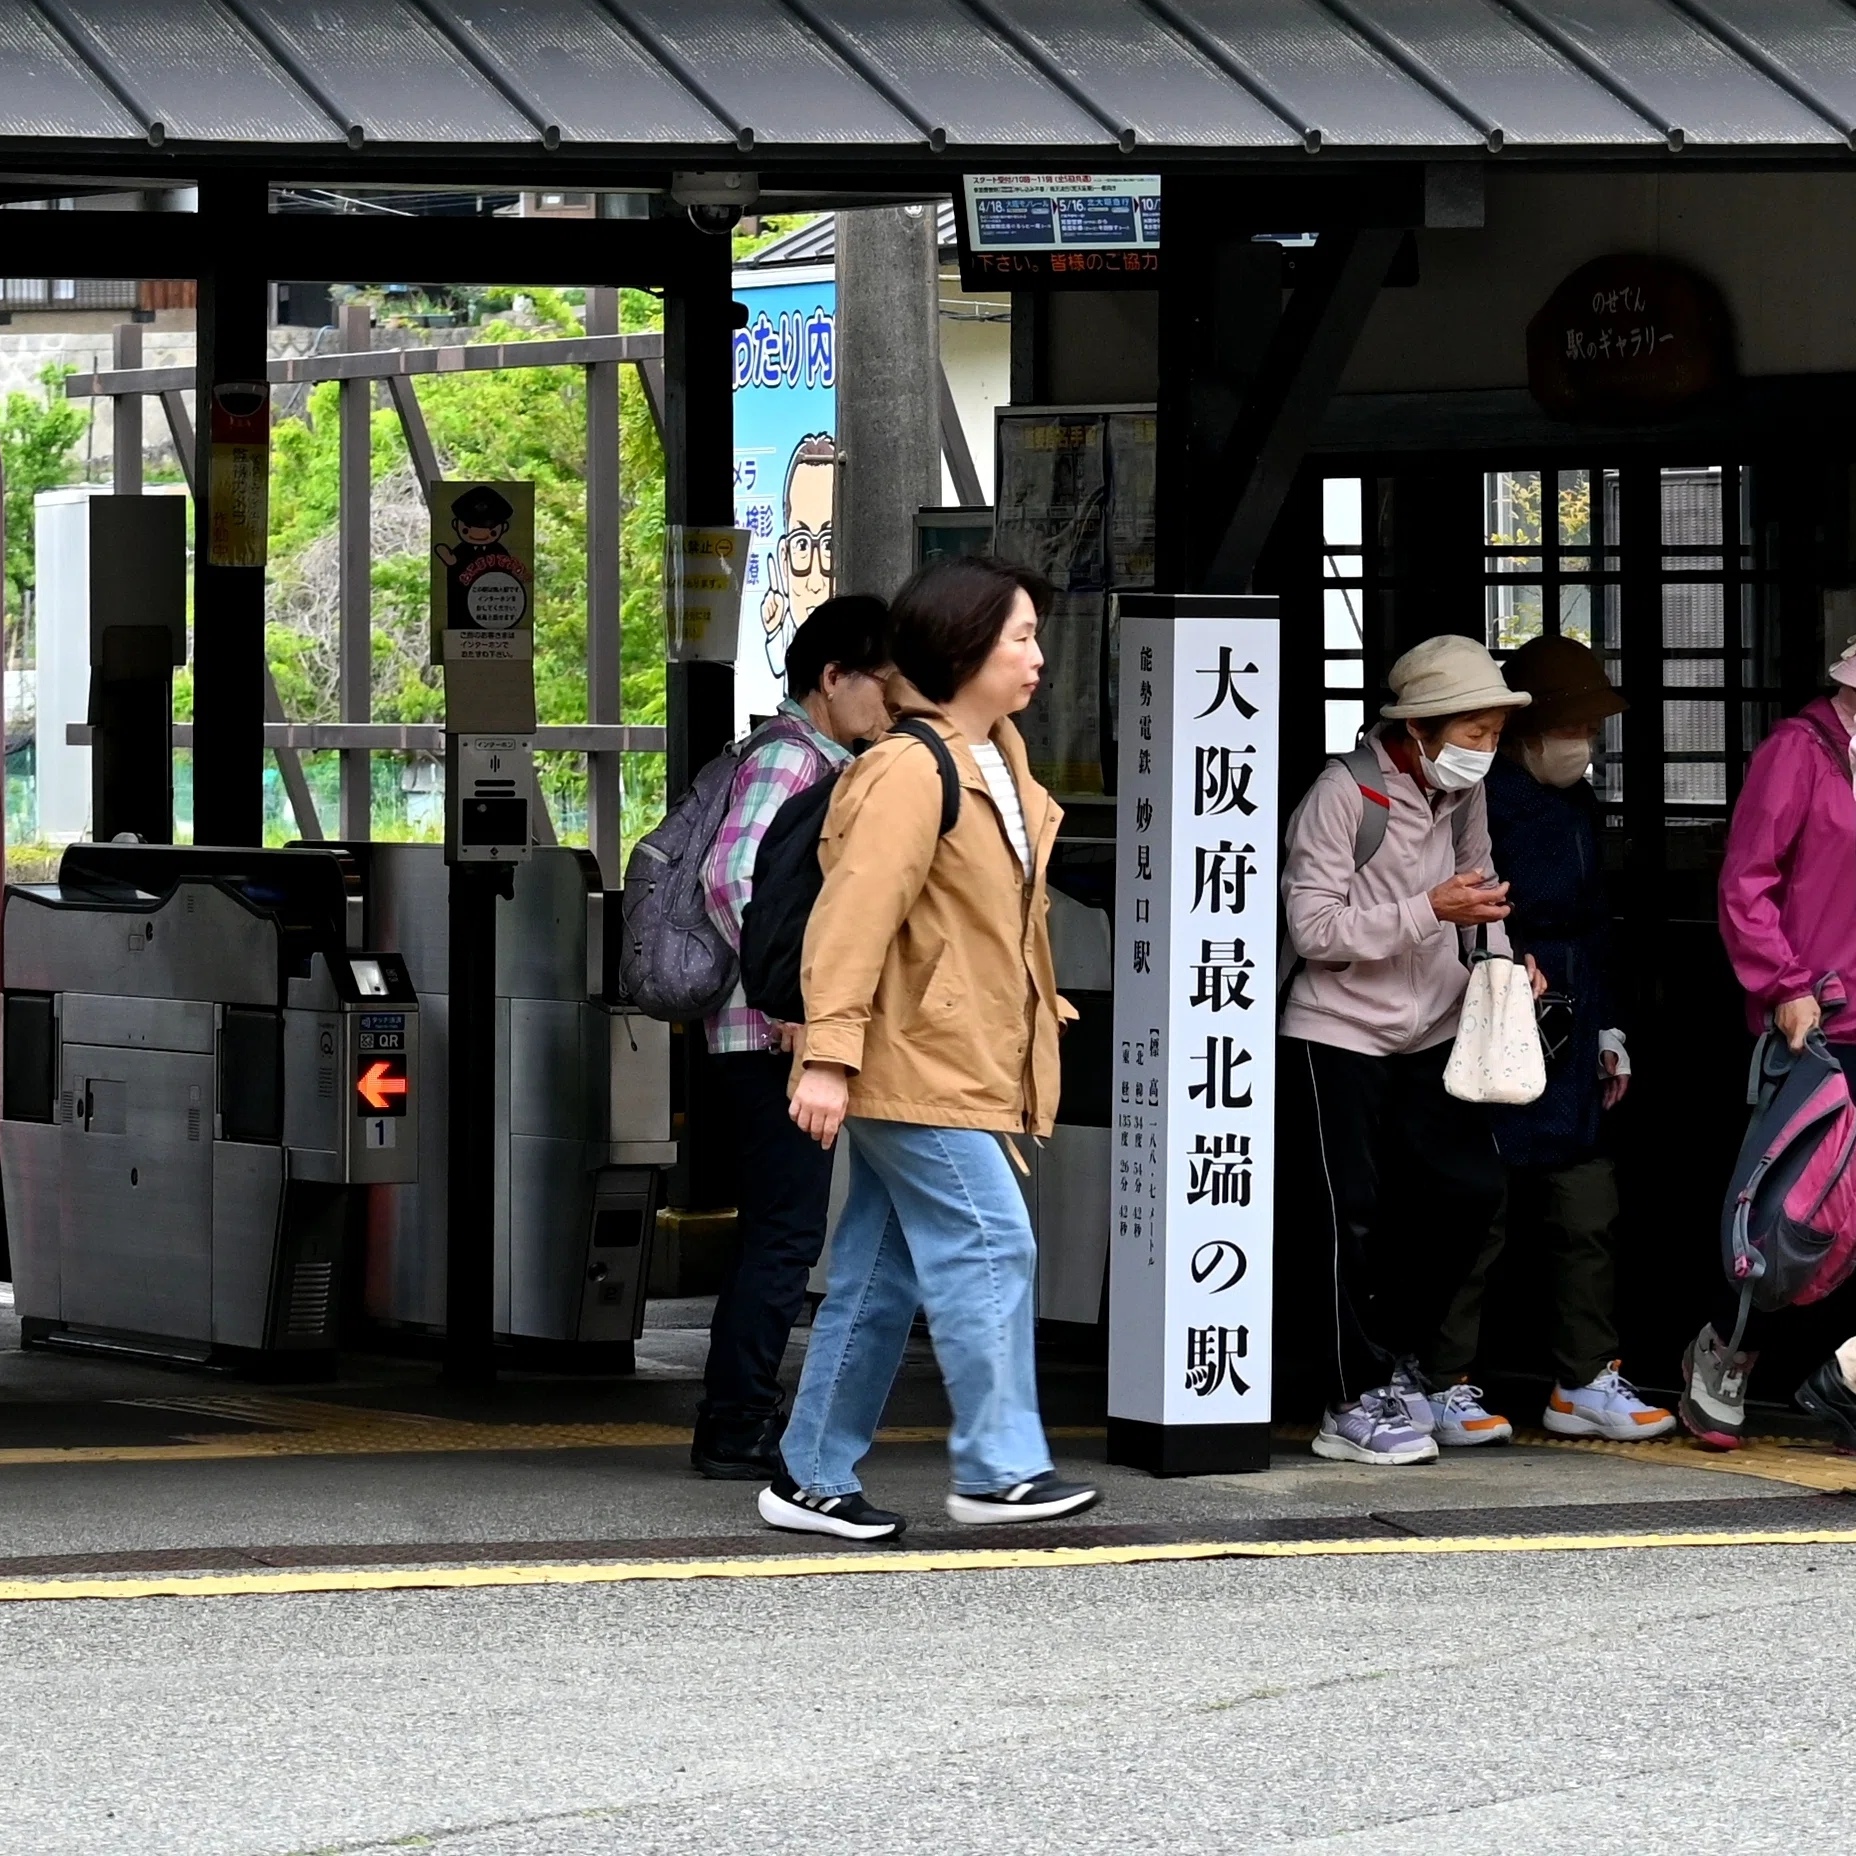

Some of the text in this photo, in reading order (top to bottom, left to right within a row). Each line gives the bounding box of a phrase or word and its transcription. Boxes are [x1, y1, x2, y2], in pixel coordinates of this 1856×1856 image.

[979, 200, 1002, 213] 4/18
[1059, 199, 1084, 212] 5/16
[972, 253, 1157, 272] 下さい。 皆様のご協力
[1592, 285, 1646, 315] のせでん
[1566, 325, 1675, 360] 駅のギャラリー
[460, 641, 509, 649] インターホンで
[477, 741, 514, 749] インターホン
[1132, 646, 1153, 975] 能勢電鉄 妙見口駅
[1185, 645, 1260, 1398] 大阪府最北端の駅
[379, 1034, 399, 1048] QR
[375, 1119, 384, 1146] 1
[603, 1286, 618, 1301] 2
